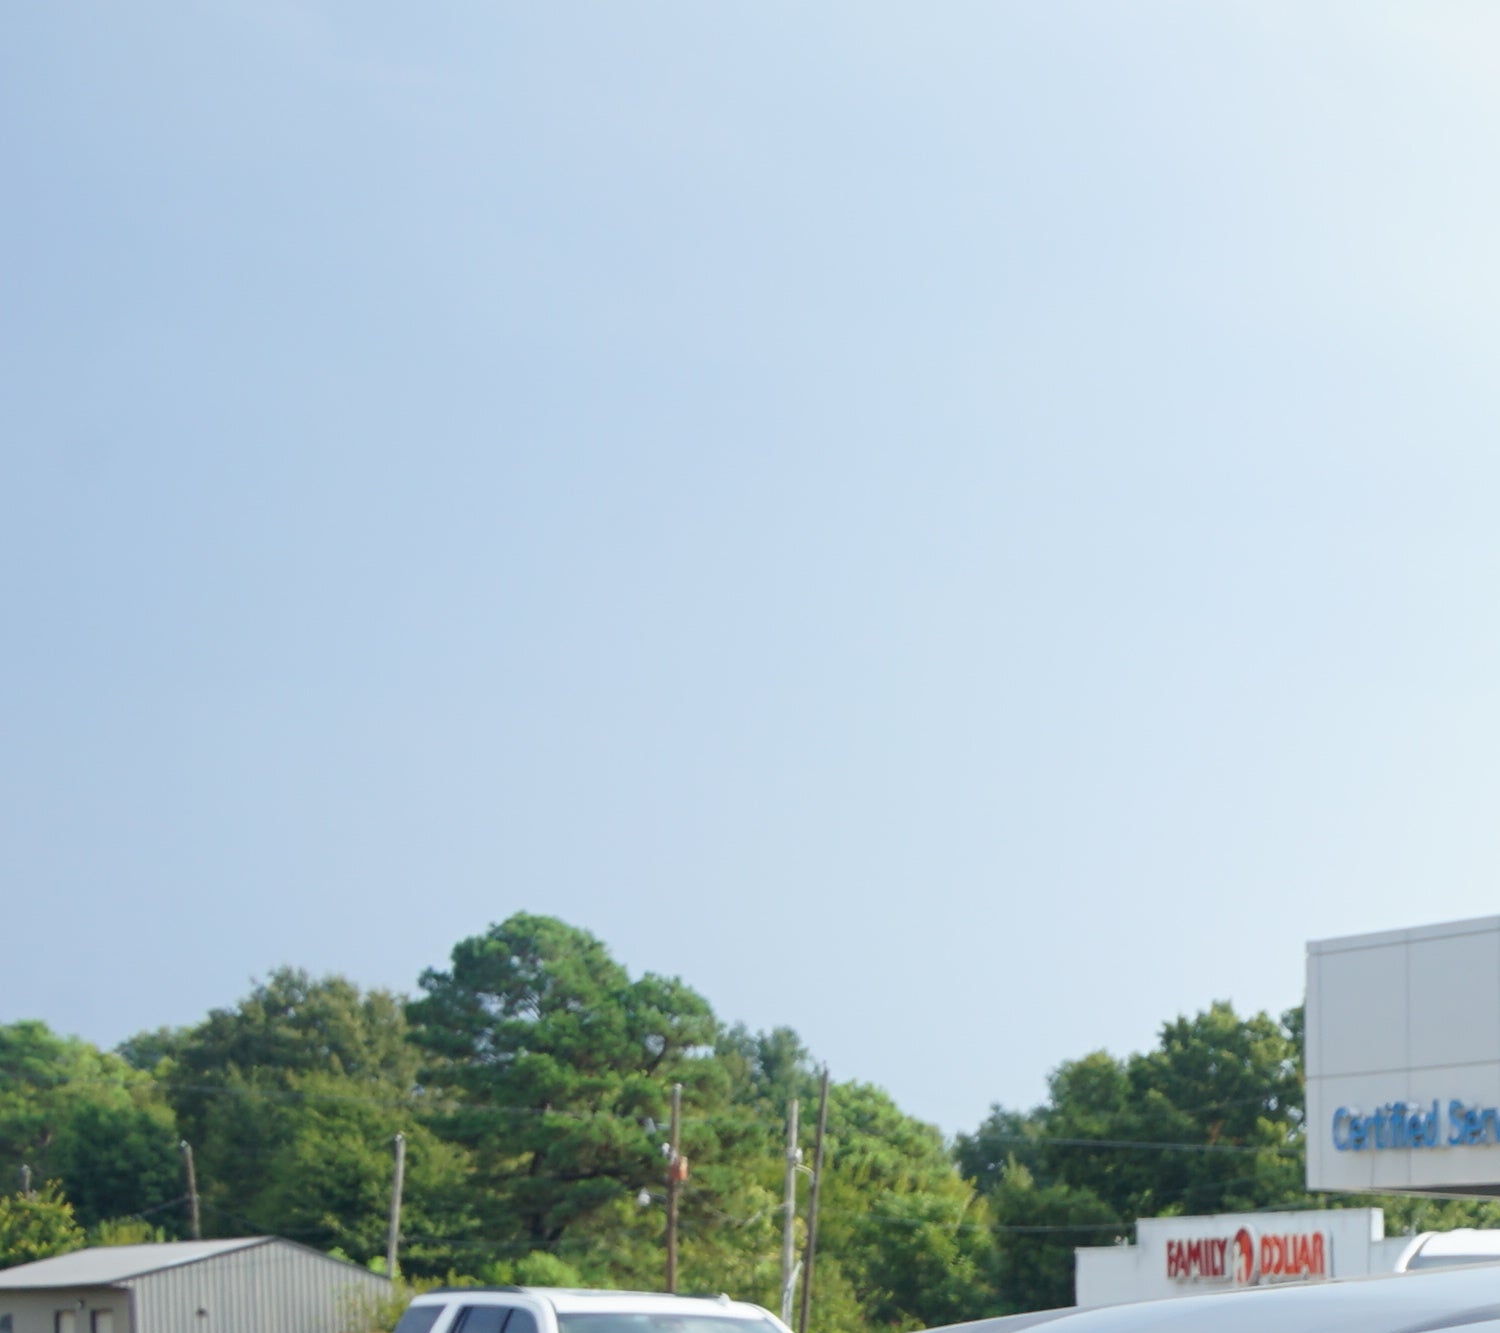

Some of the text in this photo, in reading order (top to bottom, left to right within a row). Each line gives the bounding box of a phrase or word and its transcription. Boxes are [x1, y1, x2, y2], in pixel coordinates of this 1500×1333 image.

[1332, 1098, 1439, 1152] Certified
[1166, 1230, 1326, 1279] FAMILY DOLLAR
